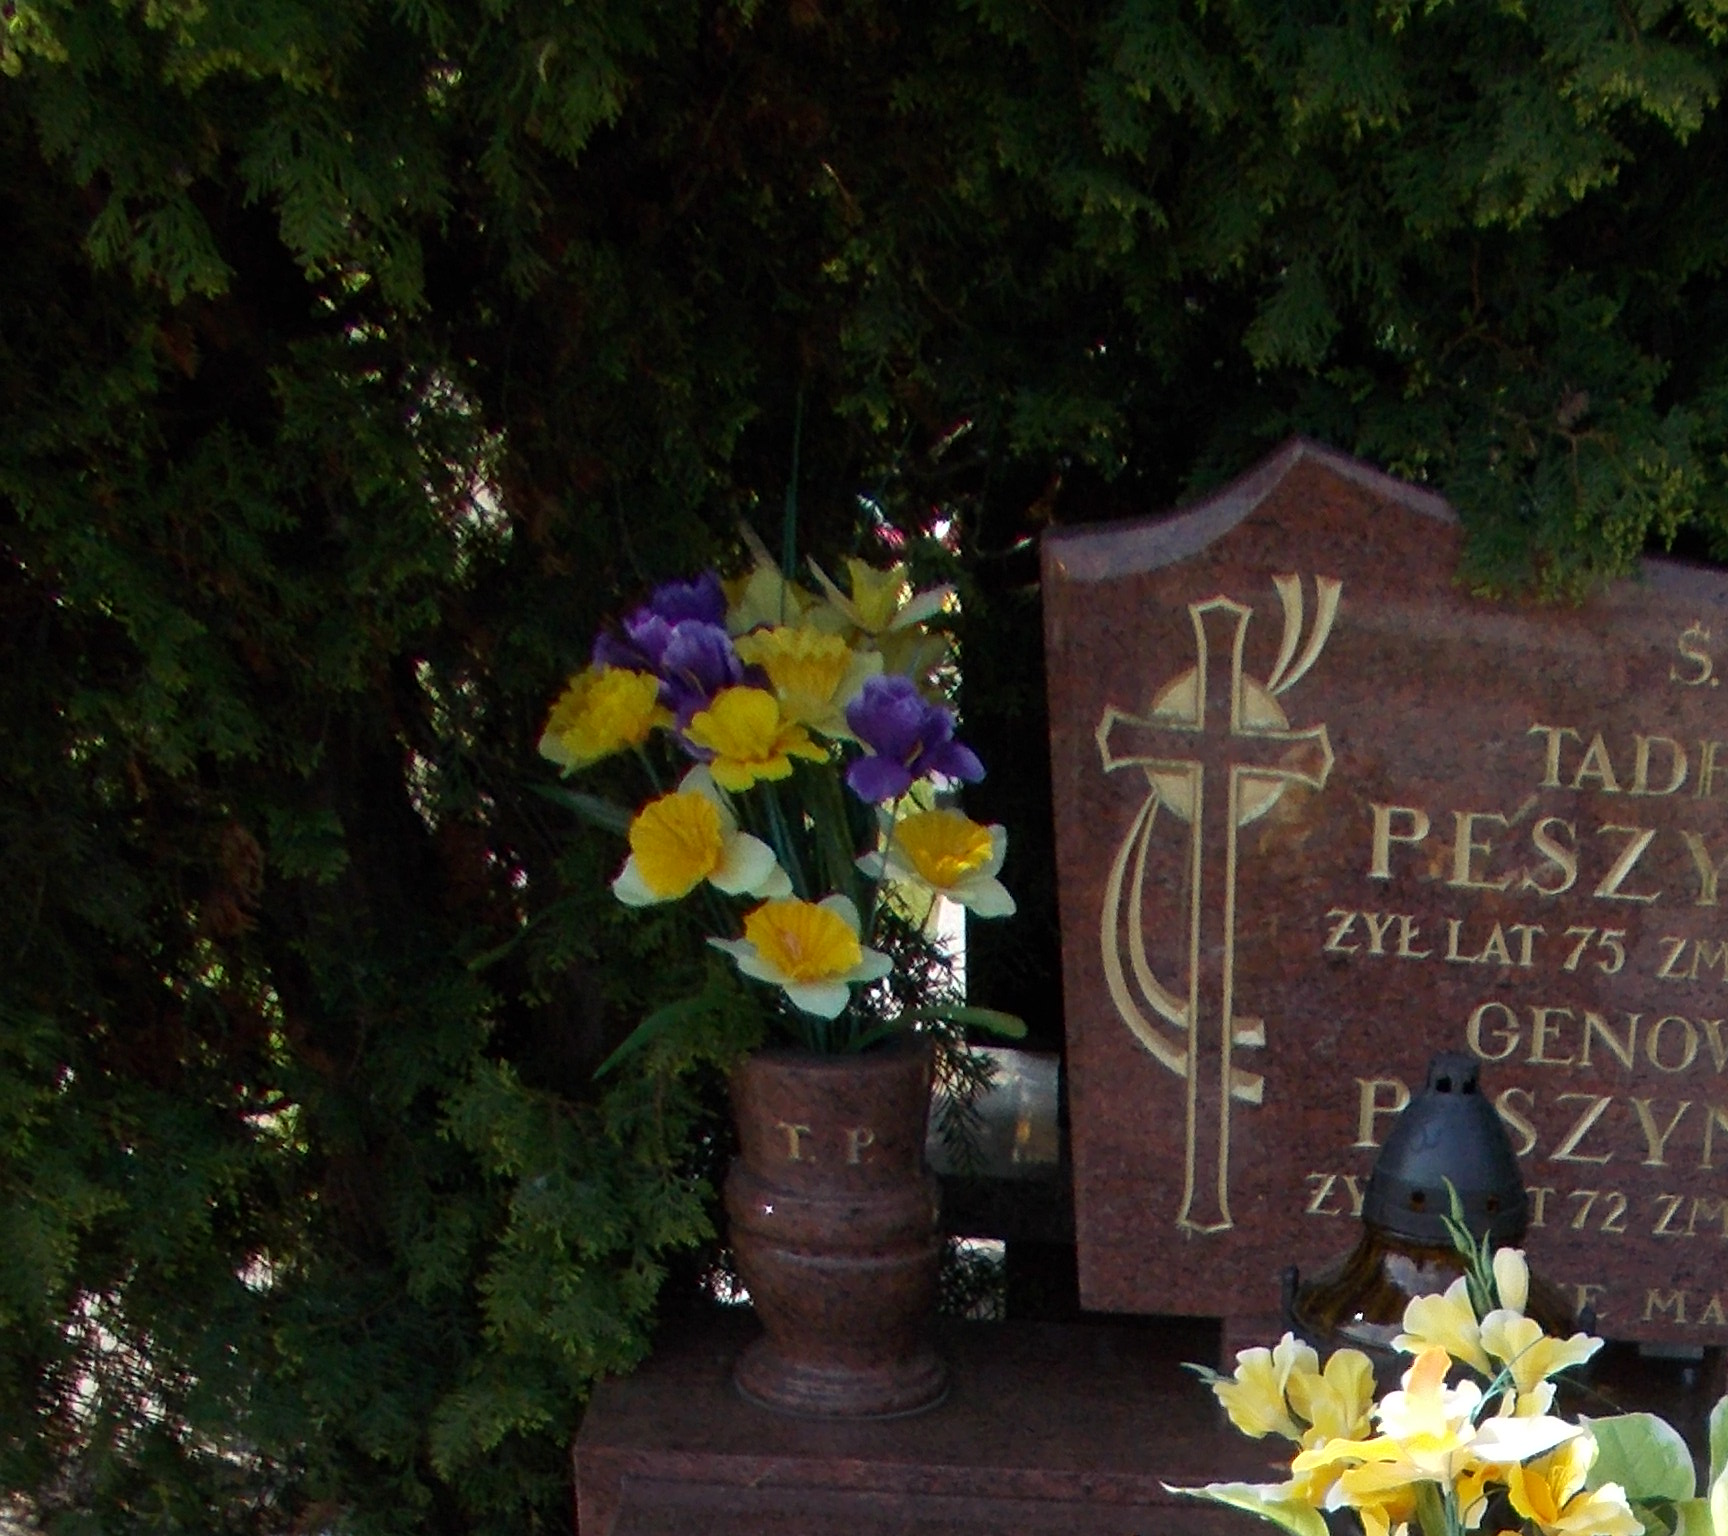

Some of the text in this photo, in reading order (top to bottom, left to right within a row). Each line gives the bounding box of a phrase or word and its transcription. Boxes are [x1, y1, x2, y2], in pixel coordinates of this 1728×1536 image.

[1444, 919, 1546, 968] LAT
[1562, 925, 1627, 974] 75
[1566, 1190, 1629, 1234] 72
